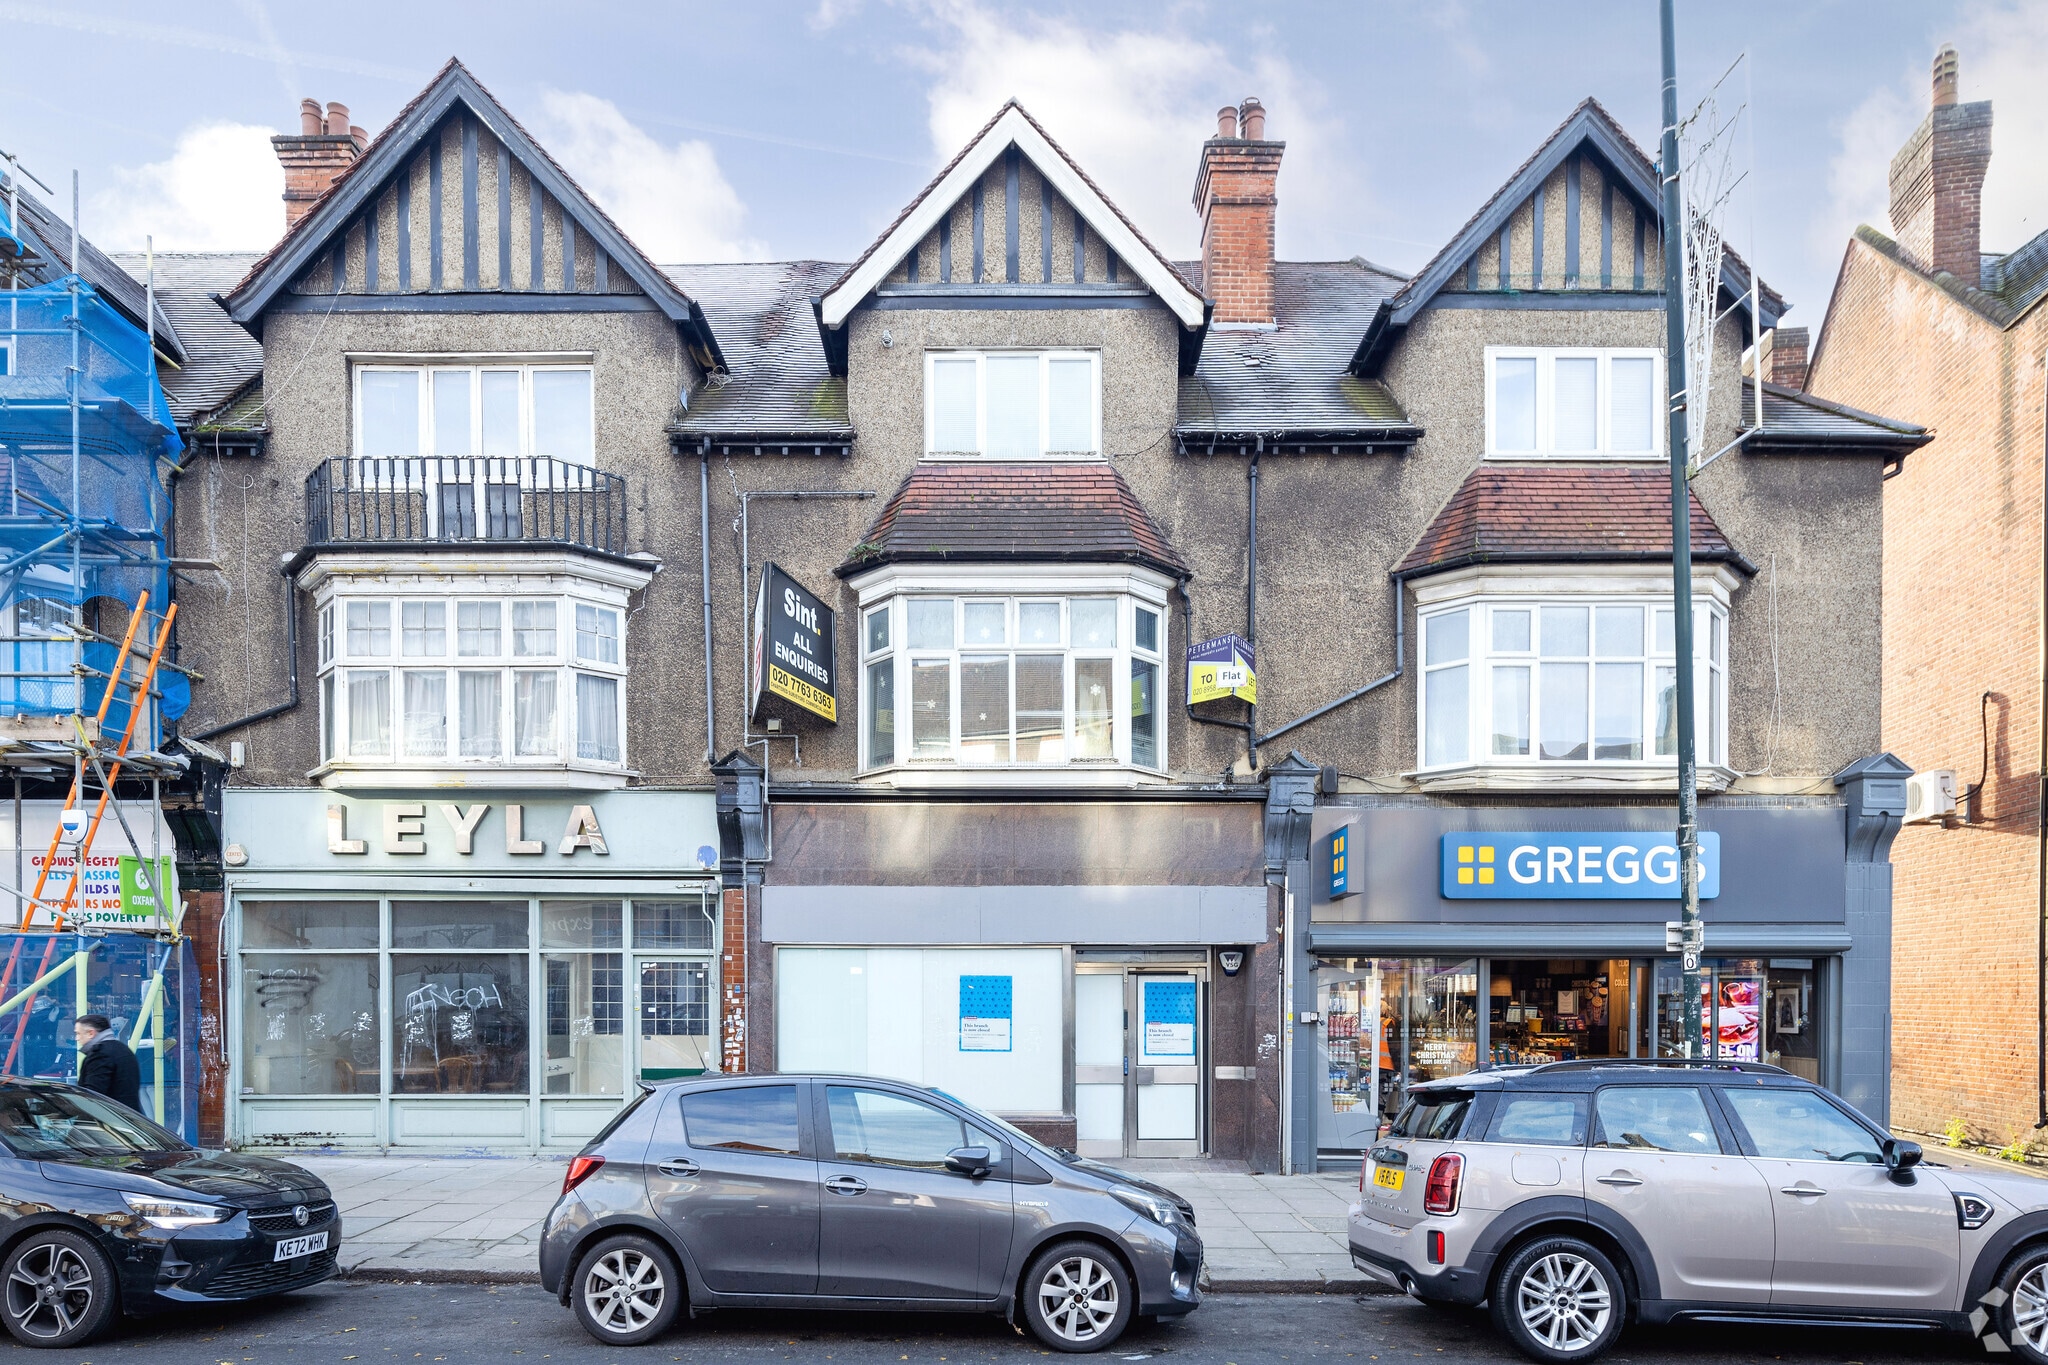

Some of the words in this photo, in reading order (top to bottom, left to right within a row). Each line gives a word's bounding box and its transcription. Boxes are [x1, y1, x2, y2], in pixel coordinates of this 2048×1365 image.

[783, 587, 821, 636] Sint.
[793, 631, 813, 655] ALL
[1188, 635, 1231, 655] PETERMANS
[774, 640, 829, 685] ENQUIRIES
[1201, 673, 1213, 685] TO
[1222, 671, 1241, 681] Flat
[772, 668, 789, 687] 020
[790, 677, 811, 699] 7763
[813, 689, 832, 709] 6363
[327, 804, 610, 855] LEYLA
[81, 856, 119, 867] EGETA
[37, 870, 67, 880] LLS
[132, 895, 155, 906] OXFAM
[95, 912, 147, 922] POVERTY
[1423, 1043, 1447, 1051] MERRY
[1702, 1044, 1737, 1057] RLL
[1736, 1044, 1756, 1057] ON
[1416, 1051, 1456, 1059] CHRISTMAS
[278, 1239, 307, 1258] KE72
[307, 1233, 326, 1251] WHK
